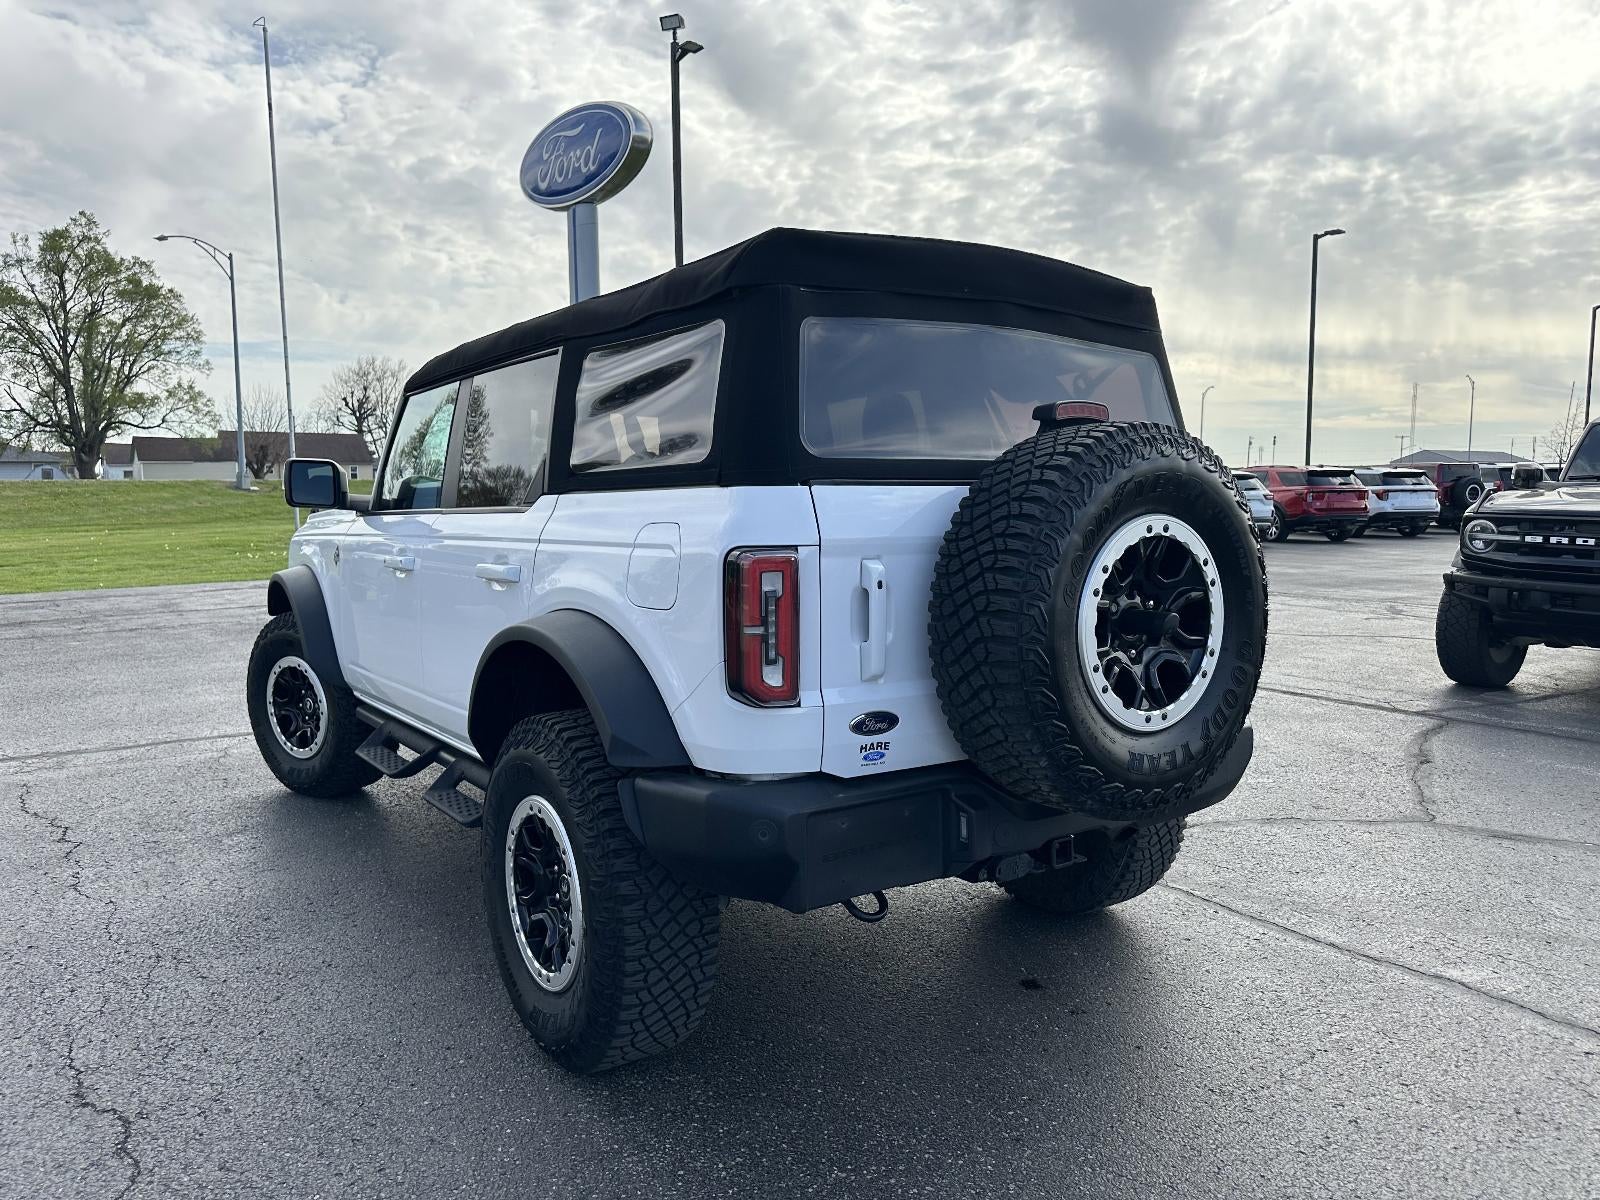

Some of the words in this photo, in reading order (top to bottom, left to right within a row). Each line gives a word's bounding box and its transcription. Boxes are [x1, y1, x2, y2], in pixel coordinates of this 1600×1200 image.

[537, 123, 602, 190] Ford
[862, 717, 889, 732] Ford
[860, 741, 890, 753] HARE
